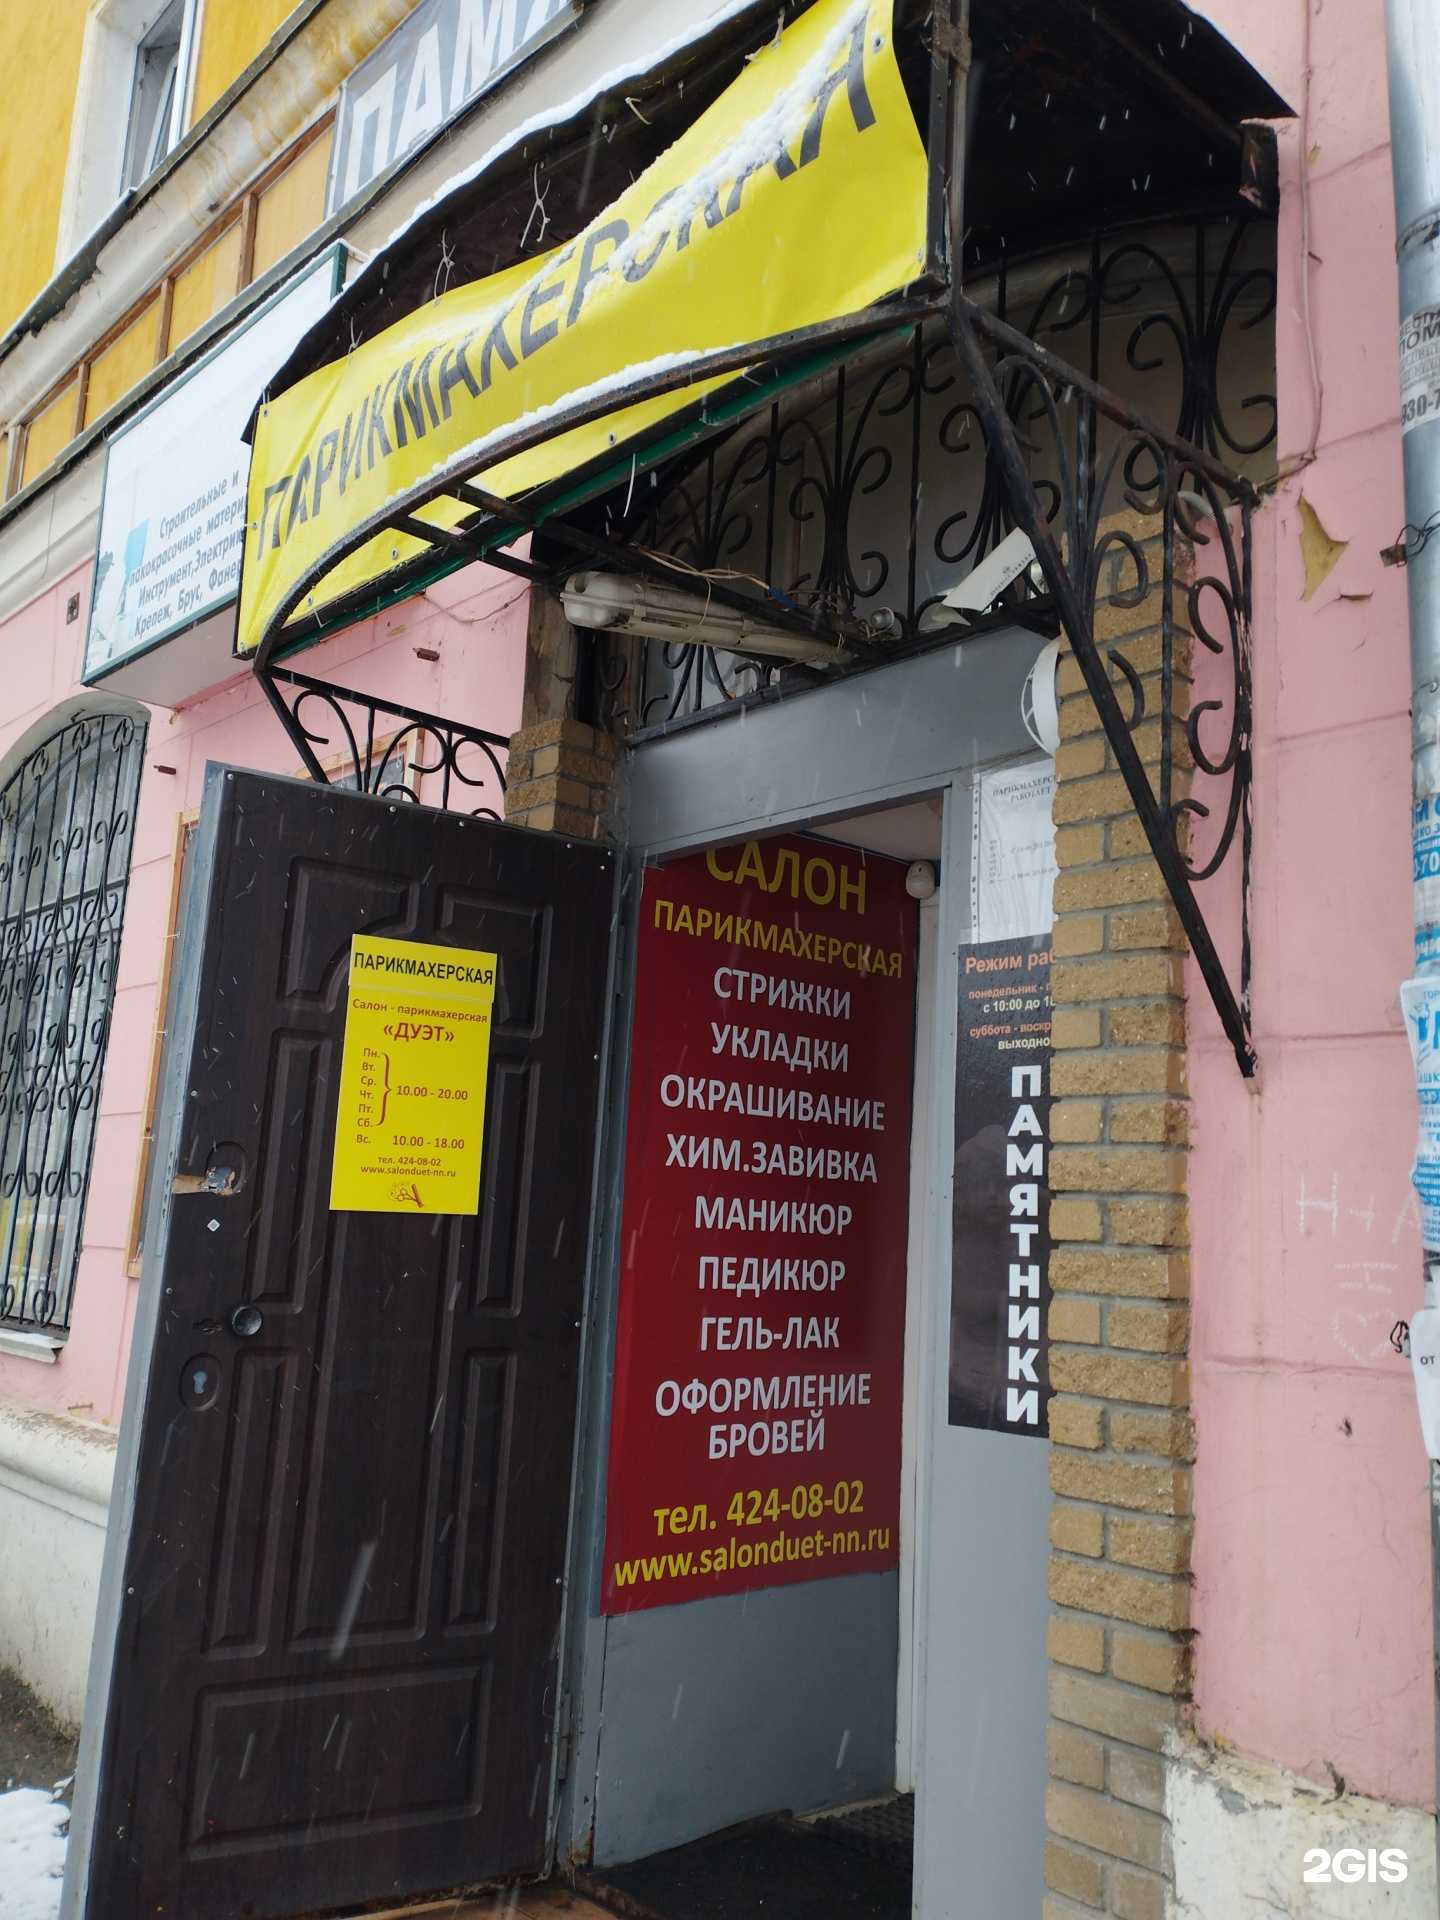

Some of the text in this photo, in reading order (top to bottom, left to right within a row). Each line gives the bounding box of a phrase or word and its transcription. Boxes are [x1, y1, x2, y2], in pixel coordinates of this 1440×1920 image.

[158, 469, 240, 540] Строительные и
[129, 495, 247, 588] лакокрасочные матери
[705, 838, 867, 915] САЛОН
[654, 898, 903, 979] ПАРИКМАХЕРСКАЯ
[353, 952, 494, 986] ПАРИКМАХЕРСКАЯ
[965, 954, 1023, 974] Режим
[713, 966, 851, 1020] СТРИЖКИ
[968, 983, 1037, 1000] понедельник
[983, 1004, 991, 1013] с
[993, 998, 1022, 1012] 10:00
[1025, 1000, 1040, 1011] до
[352, 997, 388, 1012] Салон
[397, 1003, 488, 1024] парикмахерская
[383, 1021, 455, 1043] «ДУЭТ»
[969, 1025, 1012, 1039] суббота
[362, 1047, 381, 1059] Пн.
[711, 1021, 850, 1074] УКЛАДКИ
[360, 1075, 377, 1088] Ср.
[361, 1061, 376, 1072] Вт.
[359, 1089, 374, 1100] Чт.
[396, 1084, 428, 1098] 10.00
[438, 1088, 469, 1101] 20.00
[660, 1073, 886, 1131] ОКРАШИВАНИЕ
[357, 1116, 373, 1128] Сб.
[358, 1103, 374, 1115] Пт.
[356, 1134, 371, 1145] Вс.
[392, 1134, 424, 1148] 10.00
[434, 1137, 465, 1150] 18.00
[360, 1164, 456, 1179] www.salonduet-nn.ru
[377, 1155, 441, 1167] тел. 424-08-02
[665, 1132, 879, 1184] ХИМ.ЗАВИВКА
[694, 1195, 853, 1236] МАНИКЮР
[1006, 1064, 1044, 1426] ПАМЯТНИКИ
[697, 1255, 846, 1298] ПЕДИКЮР
[700, 1315, 841, 1352] ГЕЛЬ-ЛАК
[655, 1373, 872, 1417] ОФОРМЛЕНИЕ
[708, 1408, 826, 1460] БРОВЕЙ
[652, 1479, 865, 1537] тел. 424-08-02
[614, 1524, 891, 1588] www.salonduet-nn.ru
